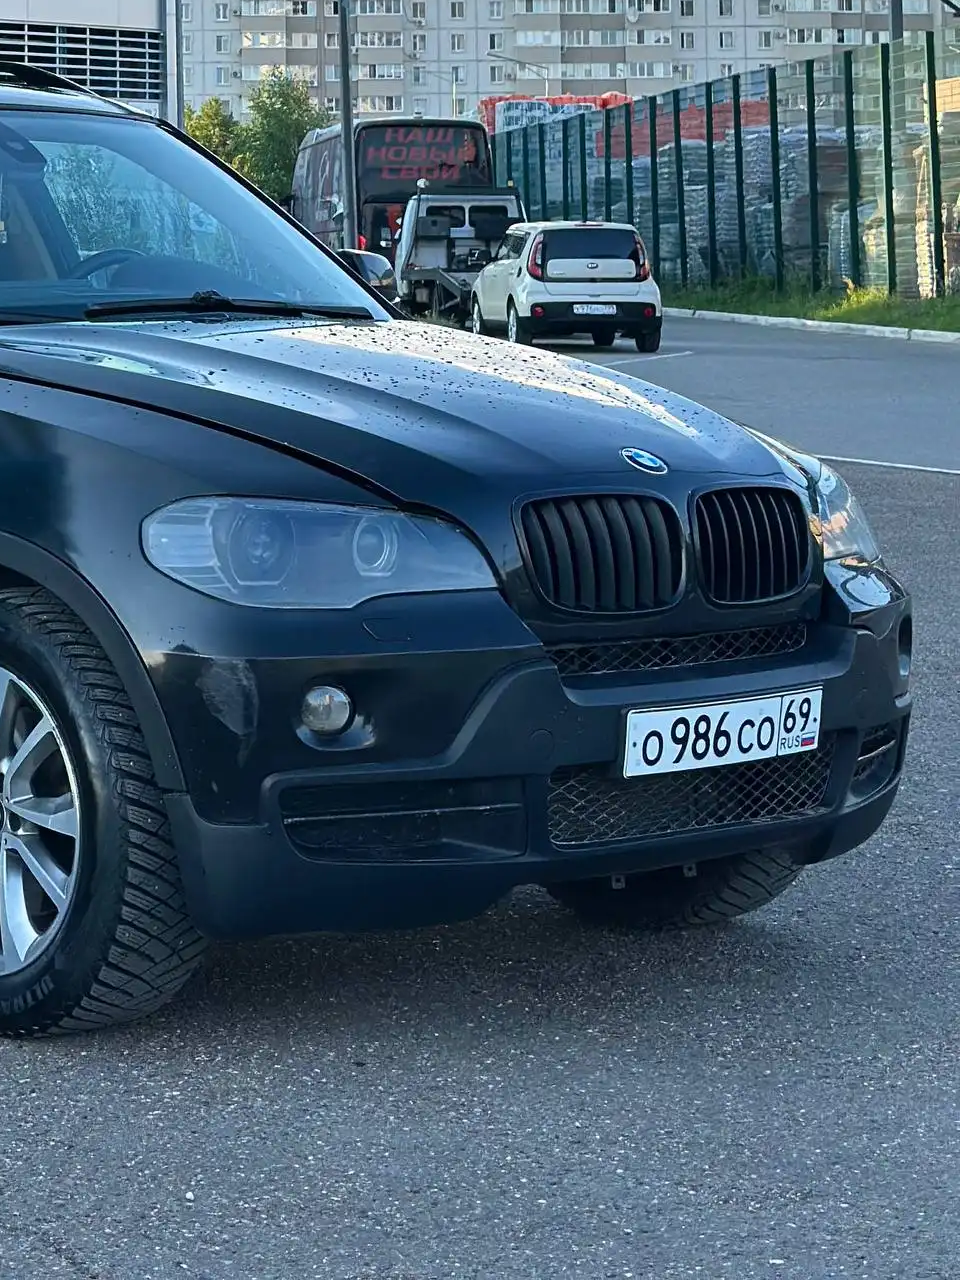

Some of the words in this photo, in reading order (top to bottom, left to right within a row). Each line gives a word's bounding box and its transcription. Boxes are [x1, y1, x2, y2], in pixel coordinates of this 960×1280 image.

[384, 127, 455, 144] НАШ
[782, 697, 812, 734] 69
[780, 737, 801, 750] RUS
